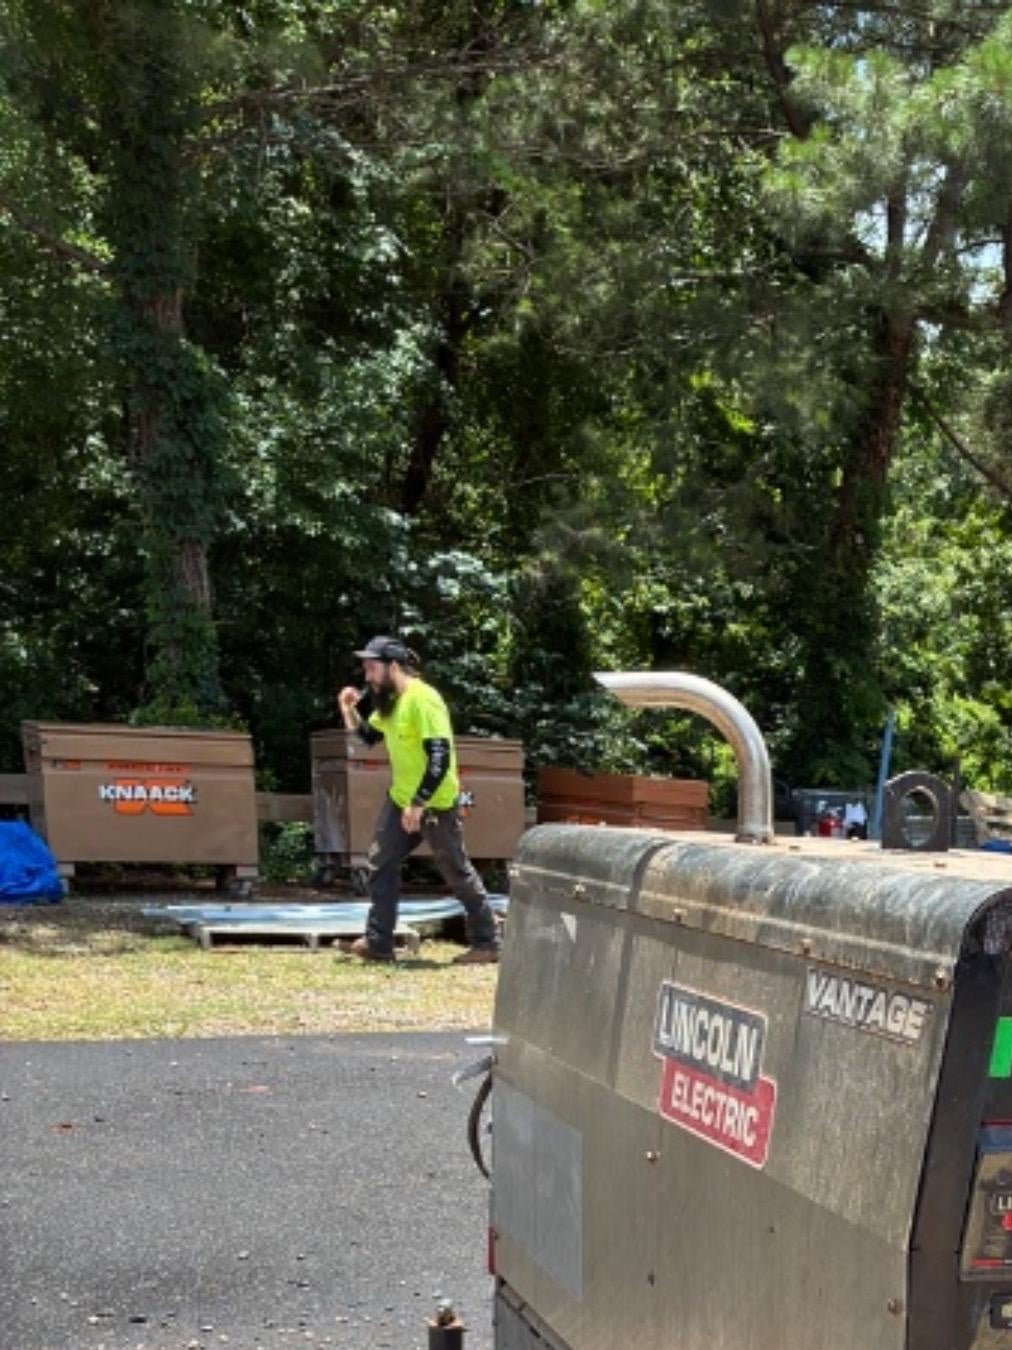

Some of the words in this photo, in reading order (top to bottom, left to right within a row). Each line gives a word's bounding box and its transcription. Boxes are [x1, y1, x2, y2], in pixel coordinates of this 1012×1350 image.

[98, 784, 194, 802] KNAACK
[659, 995, 760, 1081] LINCOLN
[807, 972, 929, 1040] VANTAGE
[671, 1073, 760, 1147] ELECTRIC
